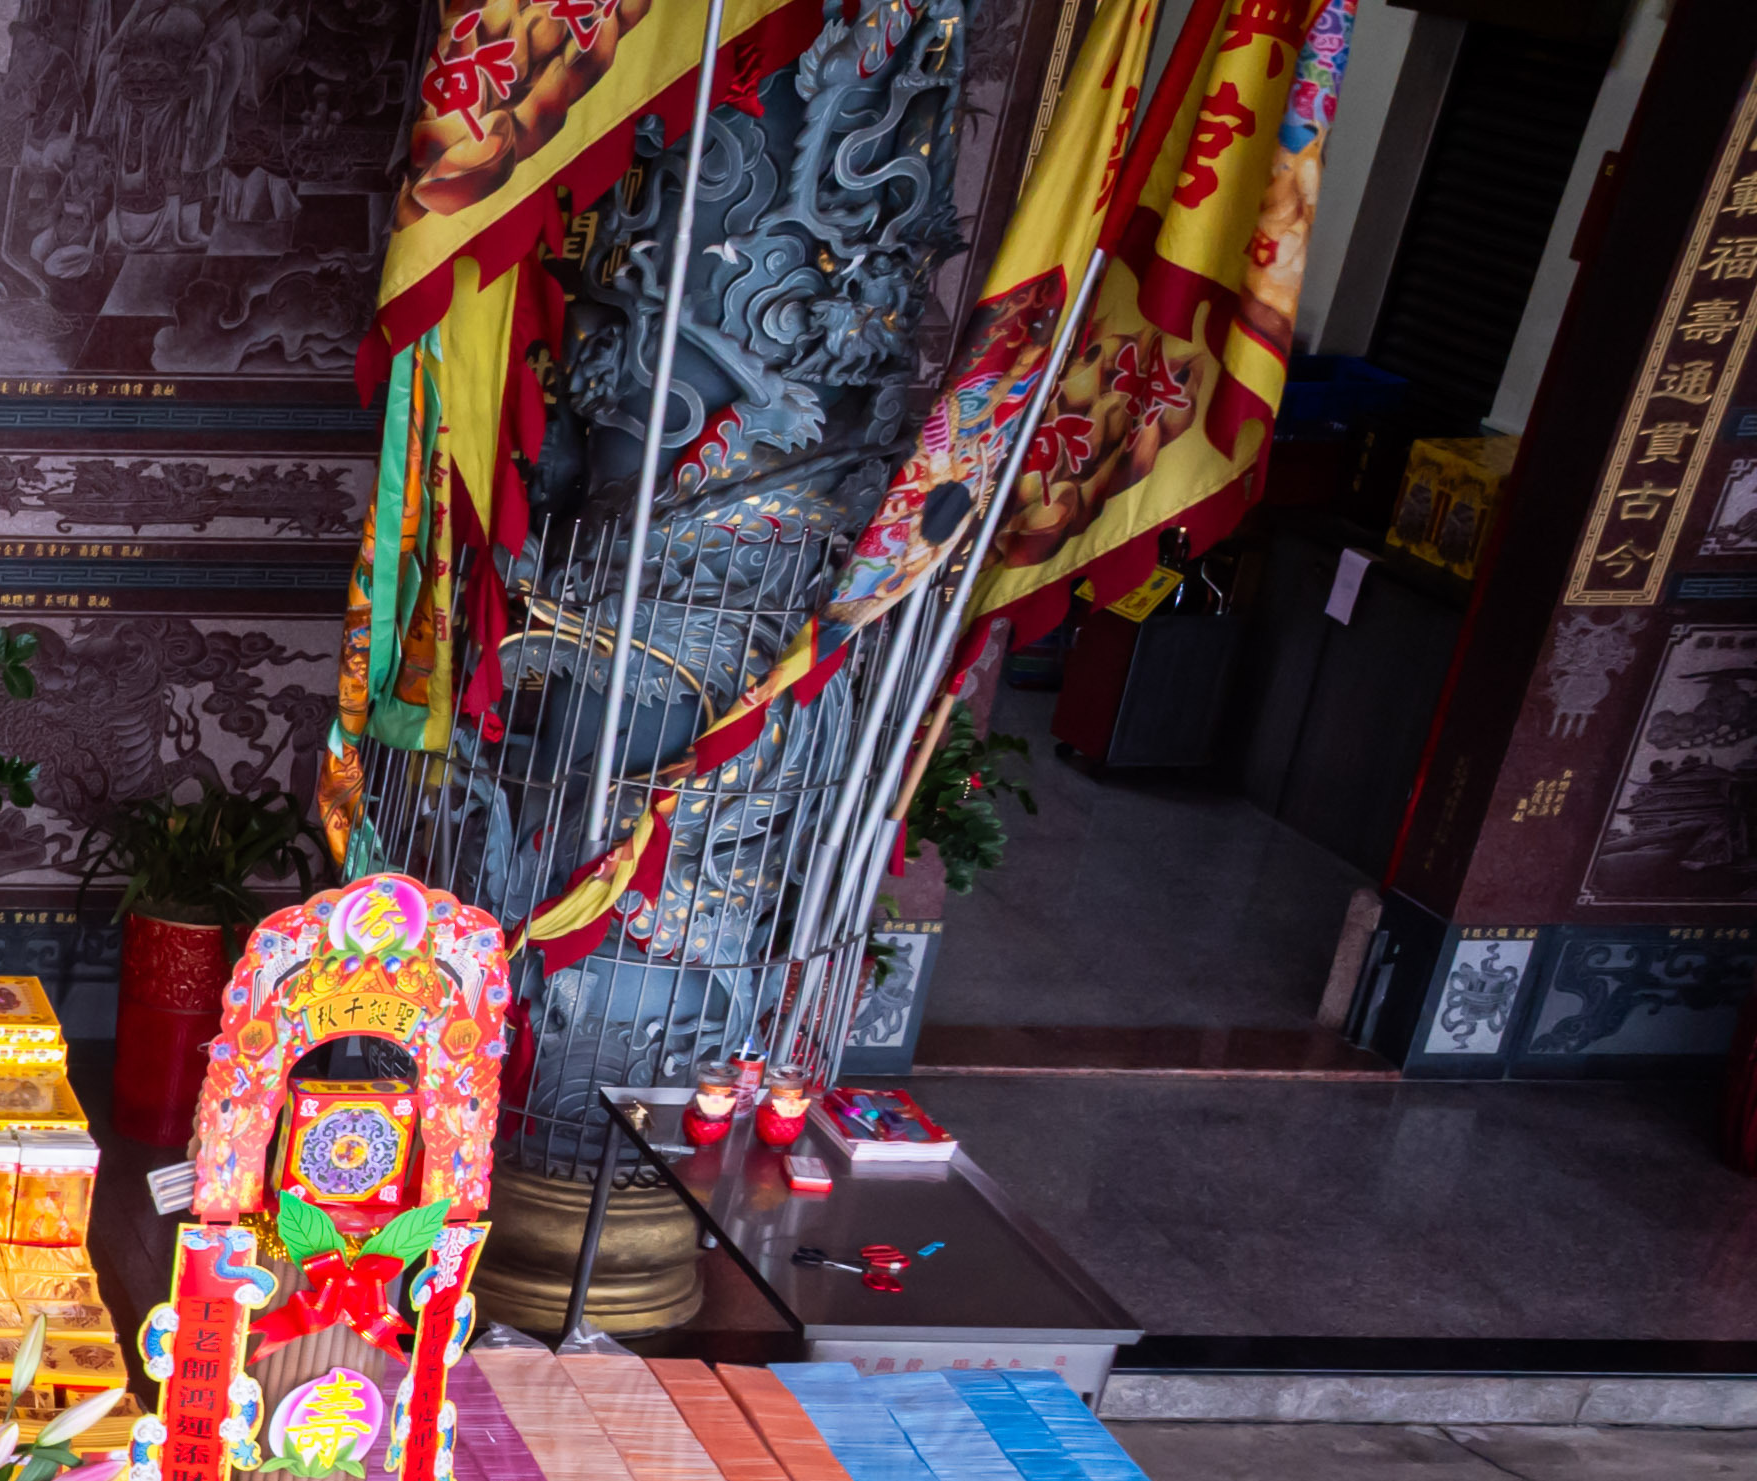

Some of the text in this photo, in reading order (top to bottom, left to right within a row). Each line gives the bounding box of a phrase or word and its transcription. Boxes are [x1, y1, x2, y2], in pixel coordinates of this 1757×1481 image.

[1595, 135, 1757, 580] 載福壽通貫古今
[284, 1371, 372, 1470] 壽
